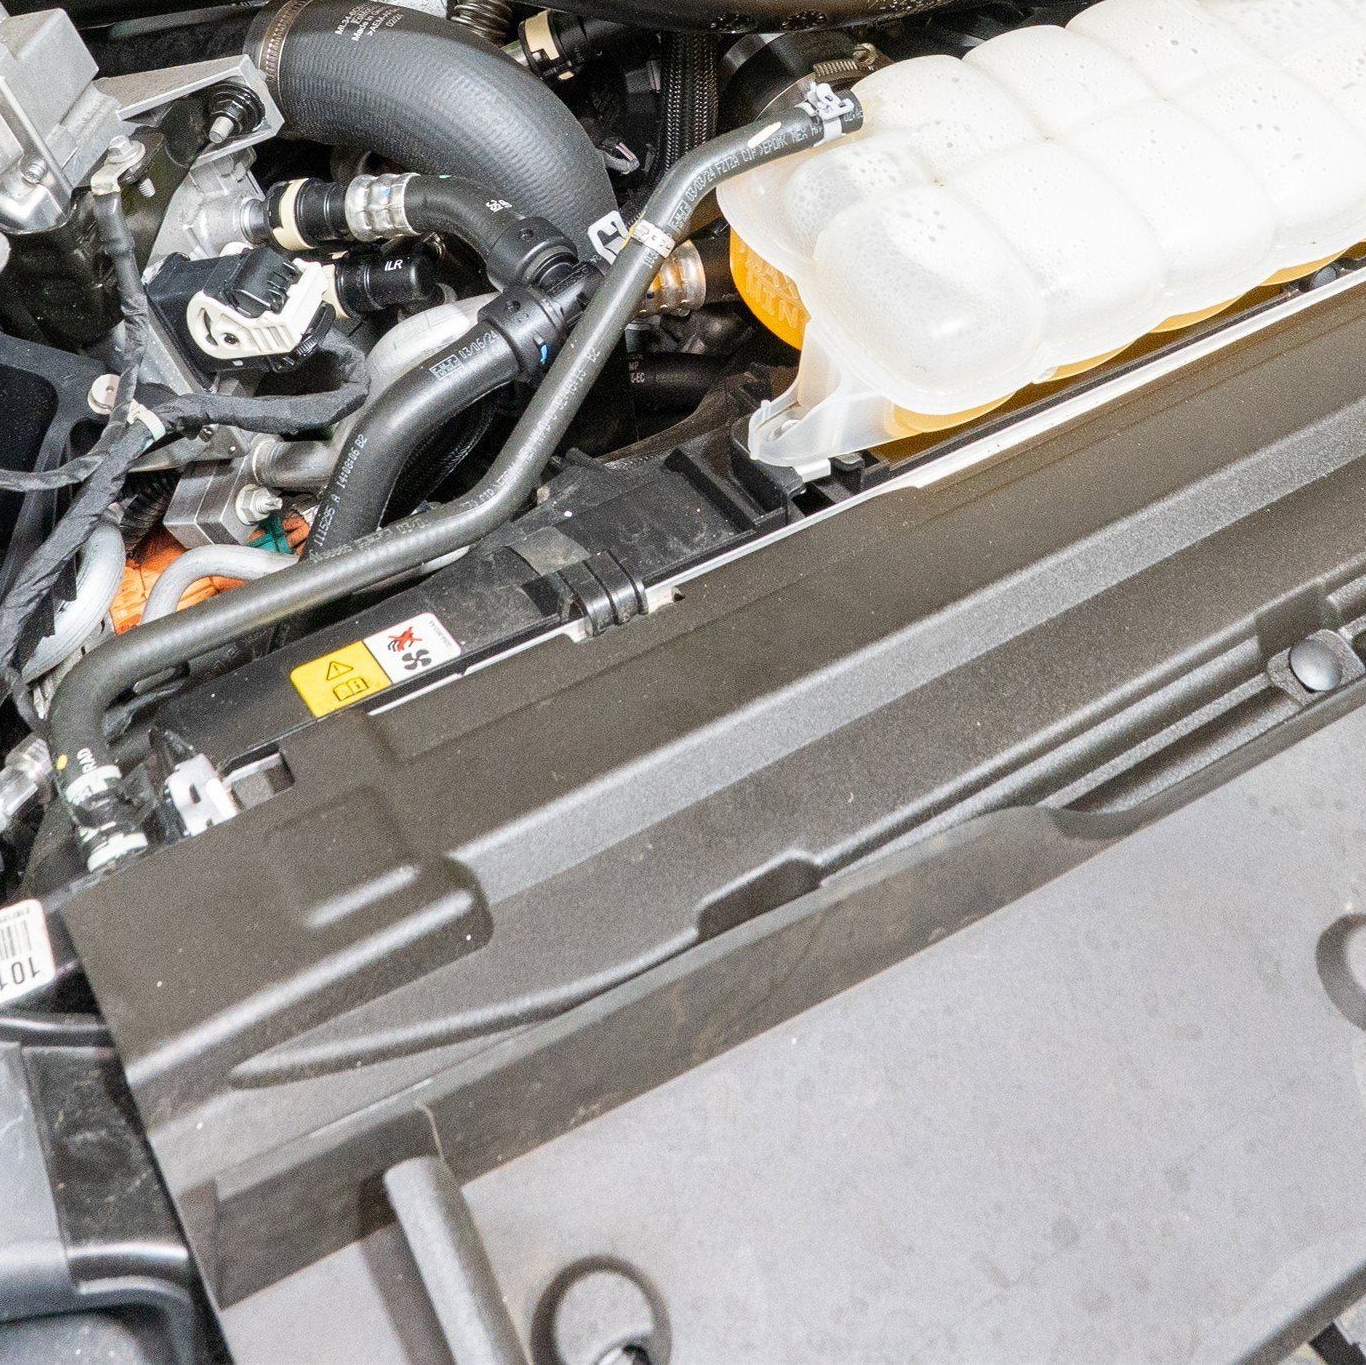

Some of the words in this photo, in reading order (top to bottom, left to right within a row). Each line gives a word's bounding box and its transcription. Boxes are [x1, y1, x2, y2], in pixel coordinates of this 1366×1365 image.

[746, 272, 800, 330] MIN
[460, 330, 498, 359] 03/06/24
[315, 506, 336, 547] 1115295
[330, 493, 341, 503] A
[355, 434, 368, 448] B2
